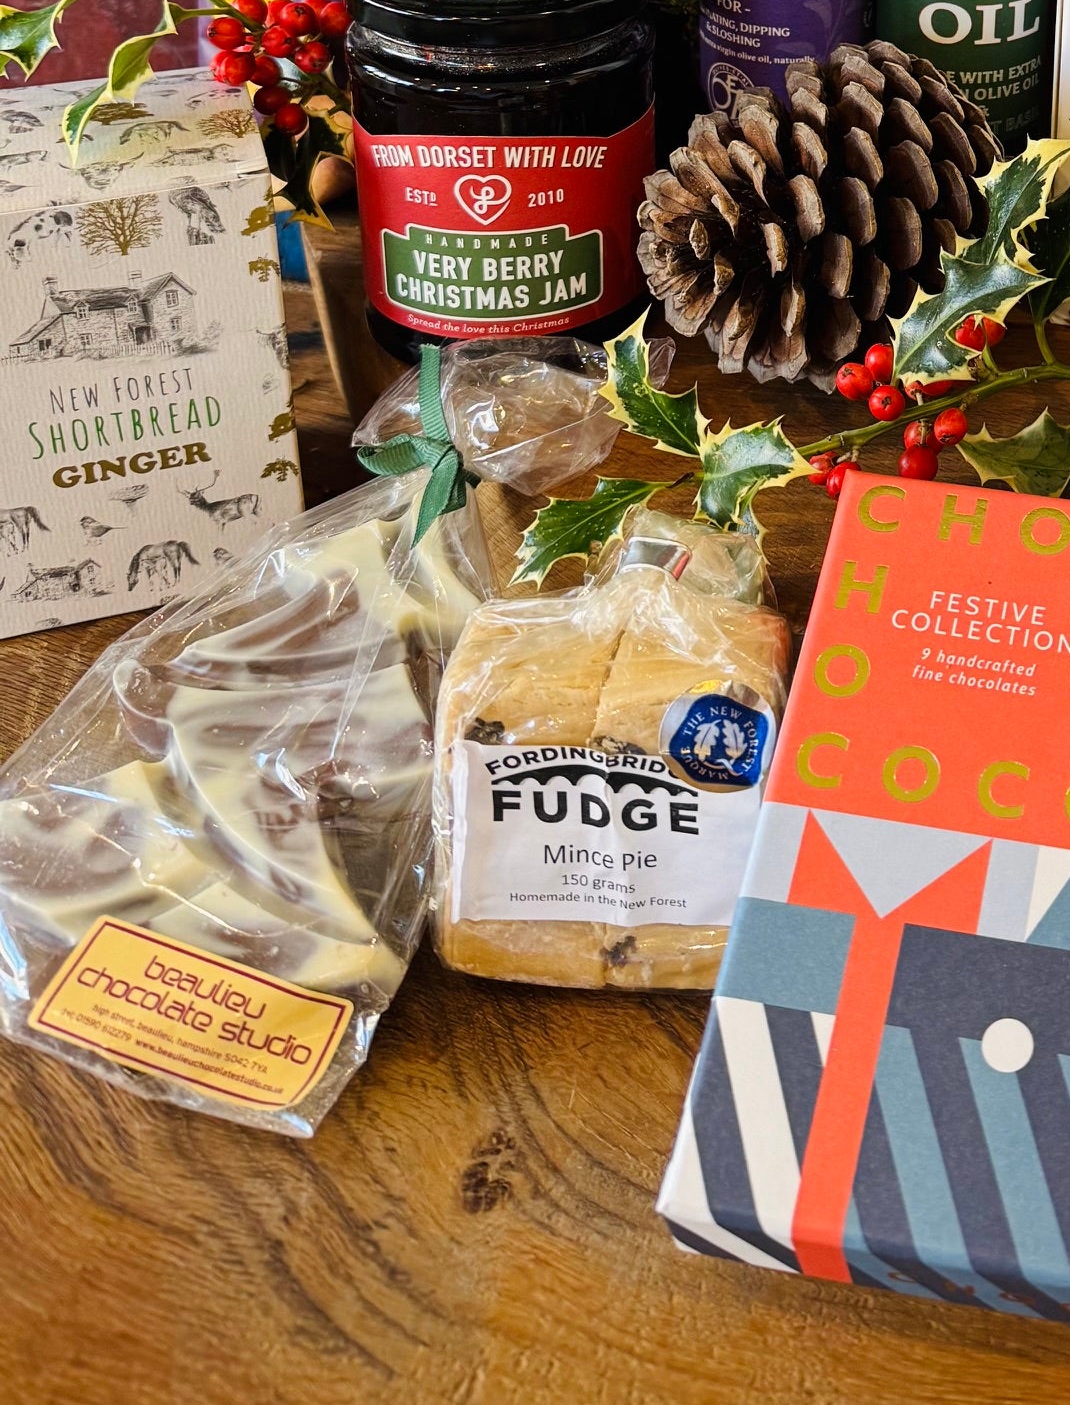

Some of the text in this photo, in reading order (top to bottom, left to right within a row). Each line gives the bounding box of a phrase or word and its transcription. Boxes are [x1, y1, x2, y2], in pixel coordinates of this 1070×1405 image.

[740, 22, 791, 37] DIPPING
[737, 51, 772, 65] olive oil,
[960, 70, 1004, 84] WITH
[974, 82, 1020, 100] OLIVE
[1023, 73, 1040, 90] OIL
[371, 144, 608, 168] FROM DORSET WITH LOVE
[528, 188, 565, 207] 2010
[425, 233, 549, 250] HANDMADE
[412, 250, 564, 282] VERY BERRY
[395, 272, 587, 310] CHRISTMAS JAM
[408, 314, 570, 334] Spread the love this Christmas
[49, 367, 194, 417] NEW FOREST
[29, 396, 222, 460] SHORTBREAD
[51, 442, 212, 490] GINGER
[929, 591, 1046, 626] FESTIVE
[920, 648, 1036, 678] 9 handcrafted
[912, 665, 1036, 697] fine chocolates
[682, 706, 760, 772] THE NEW FOREST
[492, 790, 699, 836] FUDGE
[543, 844, 658, 871] Mince Pie
[562, 874, 636, 894] 150 grams
[509, 892, 687, 910] Homemade in the New Forest
[144, 955, 267, 1020] beaulieu
[76, 966, 313, 1066] chocolate studio
[224, 1053, 268, 1075] SO42 7YA
